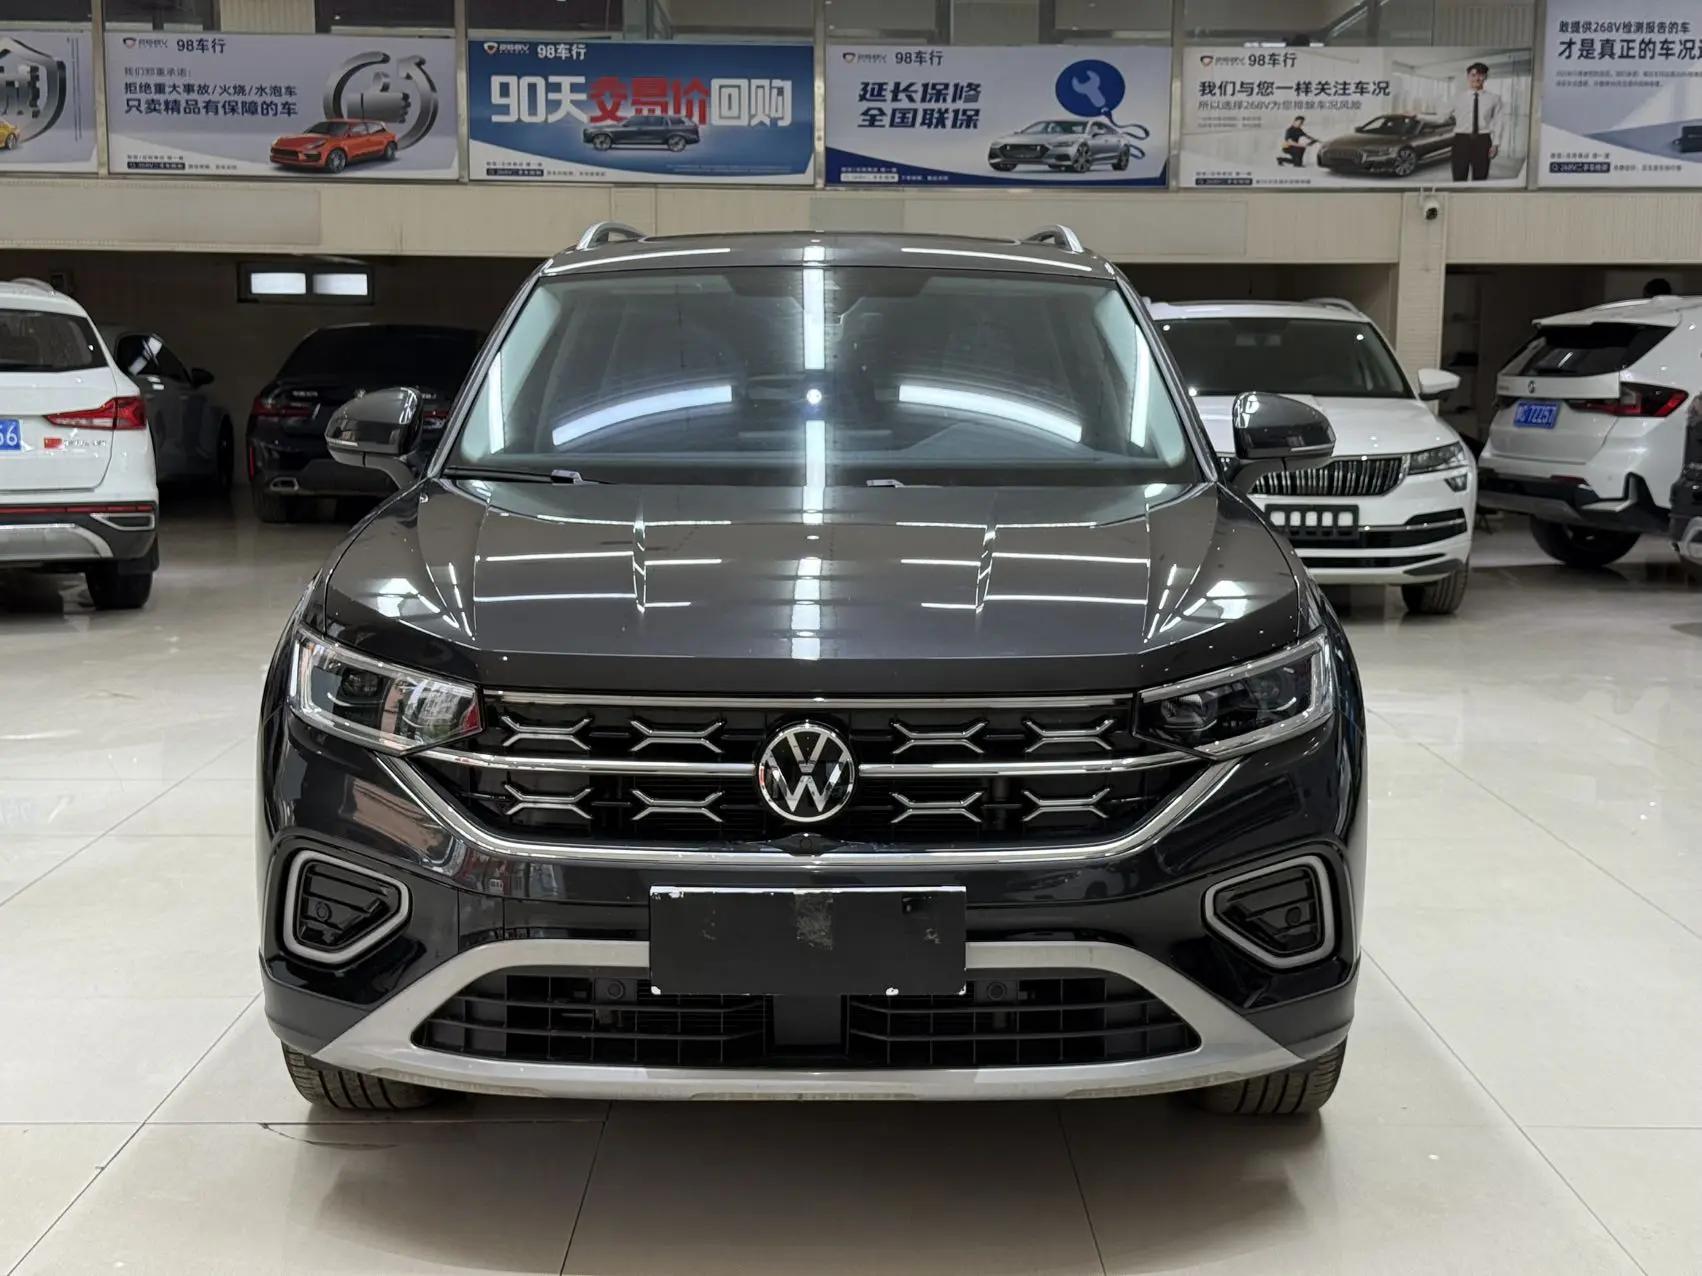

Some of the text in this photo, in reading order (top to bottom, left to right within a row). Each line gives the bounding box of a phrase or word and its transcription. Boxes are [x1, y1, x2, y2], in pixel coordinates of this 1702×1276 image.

[176, 37, 226, 54] 98车行
[537, 43, 587, 61] 98车行
[1557, 38, 1702, 60] 才是真正的车况
[895, 50, 944, 66] 98车行
[1248, 52, 1297, 68] 98车行
[124, 82, 298, 97] 拒绝重大事故/火烧/水泡车
[858, 81, 982, 104] 延长保修
[1199, 80, 1391, 97] 我们与您一样关注车况
[124, 97, 298, 117] 只卖精品有保障的车
[490, 74, 793, 127] 90天交易价回购
[857, 107, 981, 130] 全国联保
